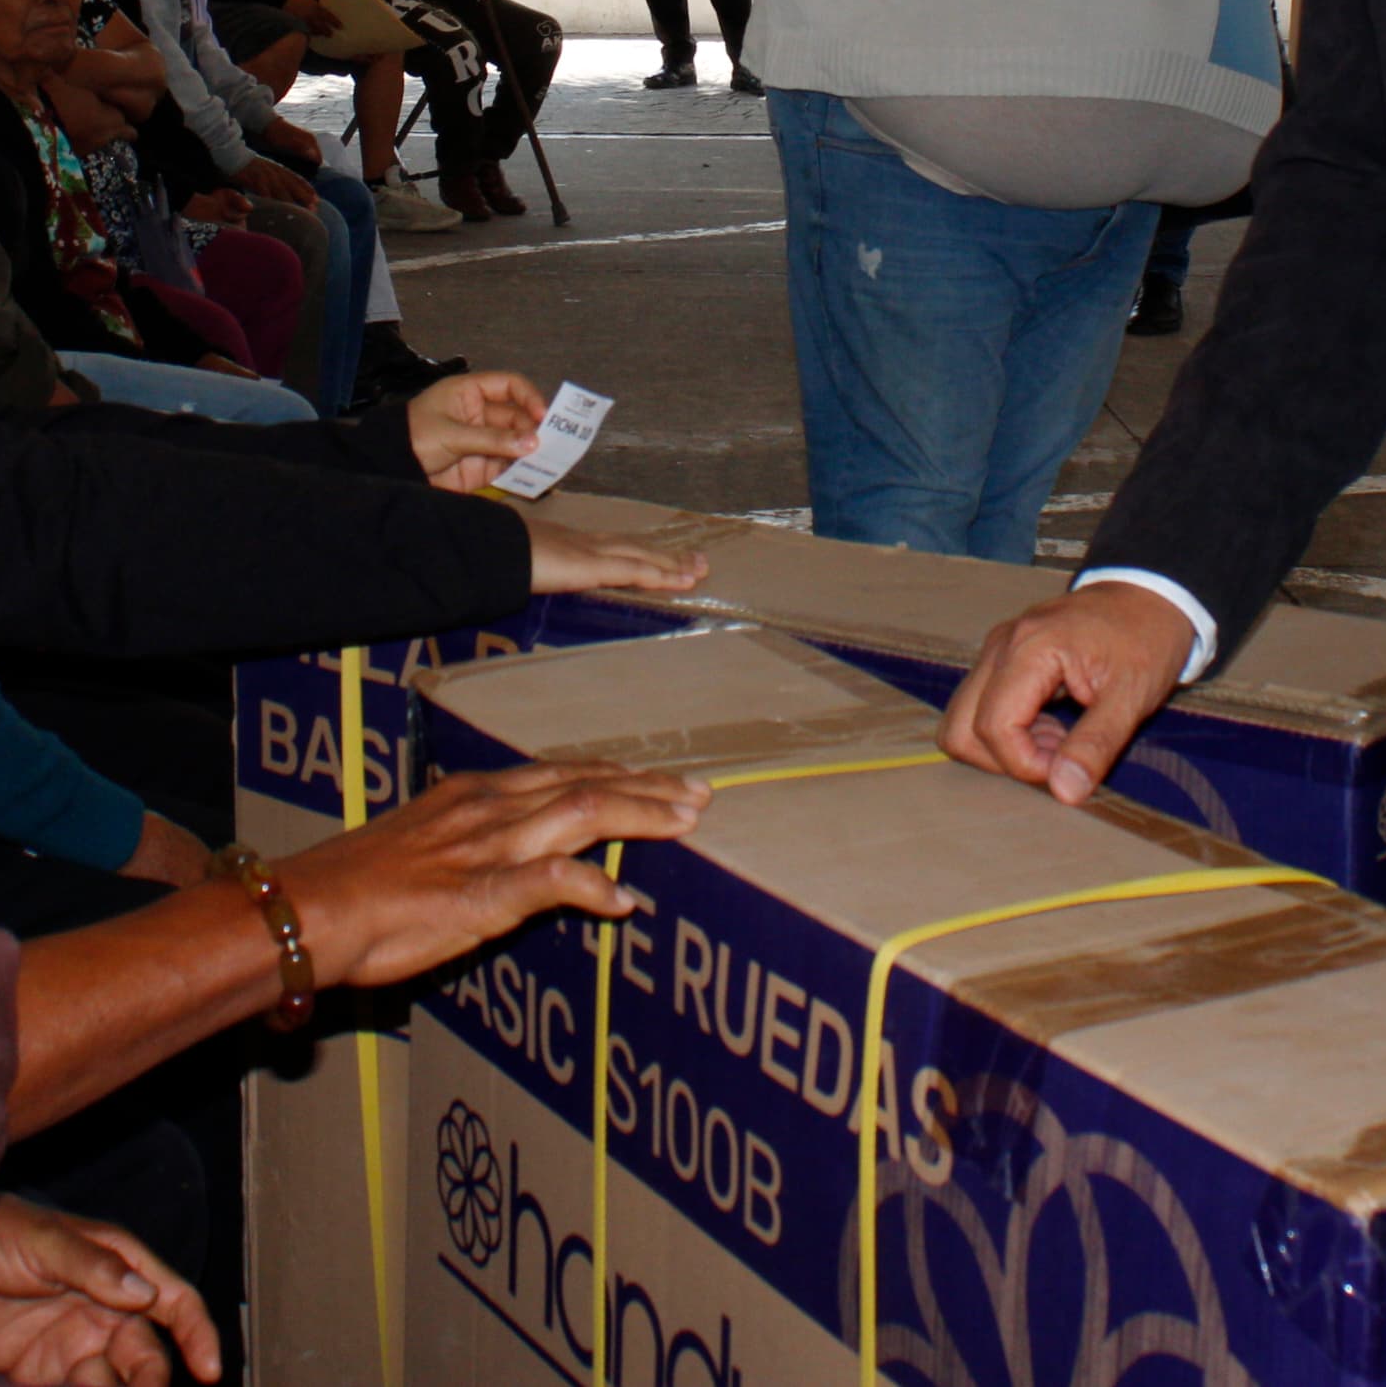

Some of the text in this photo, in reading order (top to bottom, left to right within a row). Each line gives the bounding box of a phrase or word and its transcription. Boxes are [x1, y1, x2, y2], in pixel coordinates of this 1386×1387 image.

[440, 952, 784, 1248] ASIC S100B
[673, 915, 960, 1187] RUEDAS
